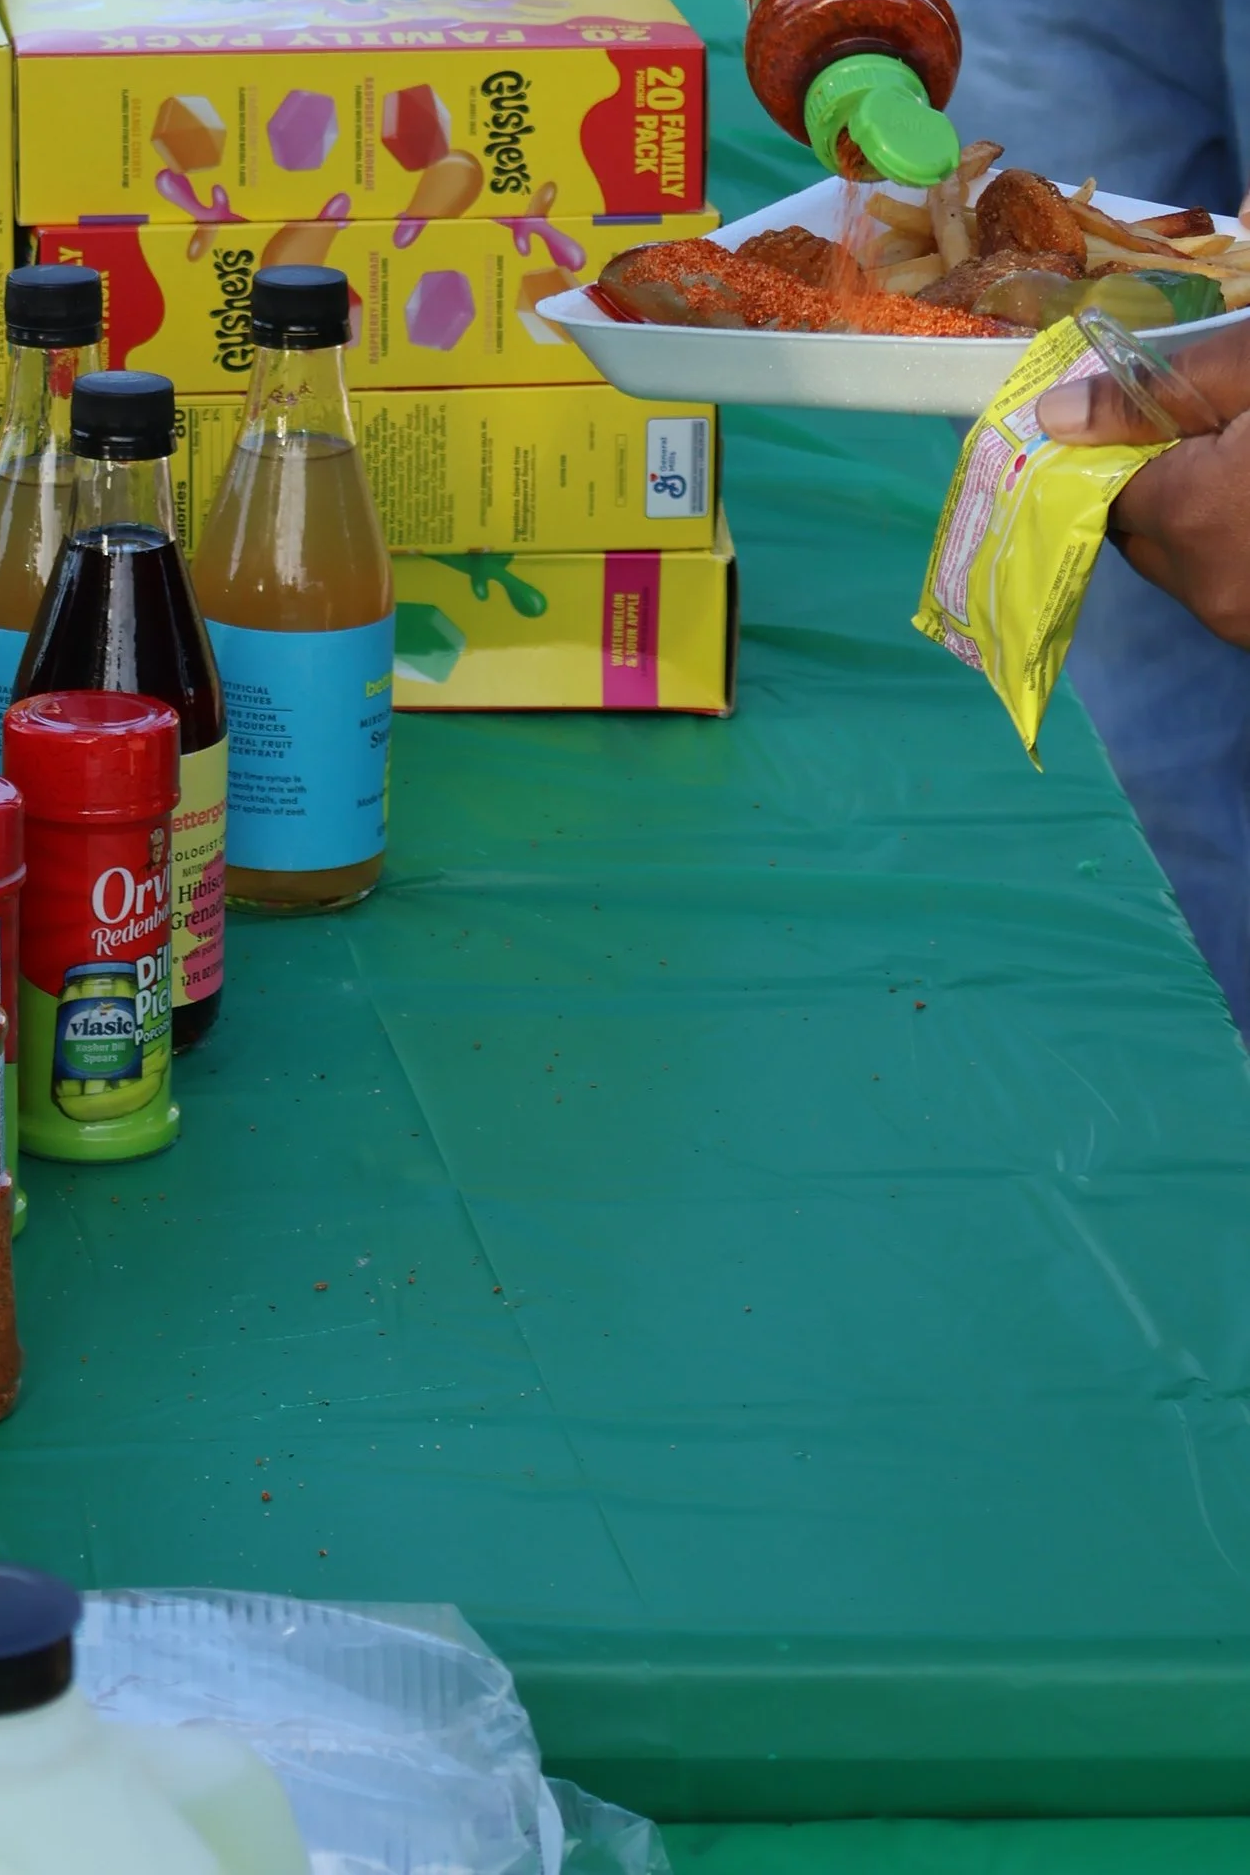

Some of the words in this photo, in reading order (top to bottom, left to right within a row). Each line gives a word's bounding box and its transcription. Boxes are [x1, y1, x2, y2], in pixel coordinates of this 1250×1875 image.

[98, 29, 278, 51] PACK
[308, 28, 525, 47] FAMILY
[646, 66, 685, 110] 20
[480, 70, 536, 196] Gushers
[635, 114, 659, 174] PACK
[364, 138, 375, 192] LEMONADE
[660, 114, 685, 198] FAMILY
[668, 451, 677, 472] Mills
[626, 593, 639, 626] APPLE
[611, 593, 624, 666] WATERMELON
[626, 629, 638, 655] SOUR
[238, 721, 286, 732] SOURCES
[246, 713, 277, 722] FROM
[233, 737, 257, 747] REAL
[262, 739, 293, 749] FRUIT
[265, 774, 291, 783] syrup
[294, 775, 301, 783] is
[231, 793, 276, 805] mocktails,
[279, 796, 298, 805] and
[257, 785, 266, 793] to
[269, 786, 284, 794] mix
[286, 786, 307, 794] with
[243, 804, 271, 815] splash
[274, 806, 284, 815] of
[181, 975, 191, 987] 12
[70, 1017, 133, 1037] vlasic
[74, 1042, 109, 1053] Kosher
[111, 1039, 127, 1052] Dill
[82, 1052, 118, 1064] Spears
